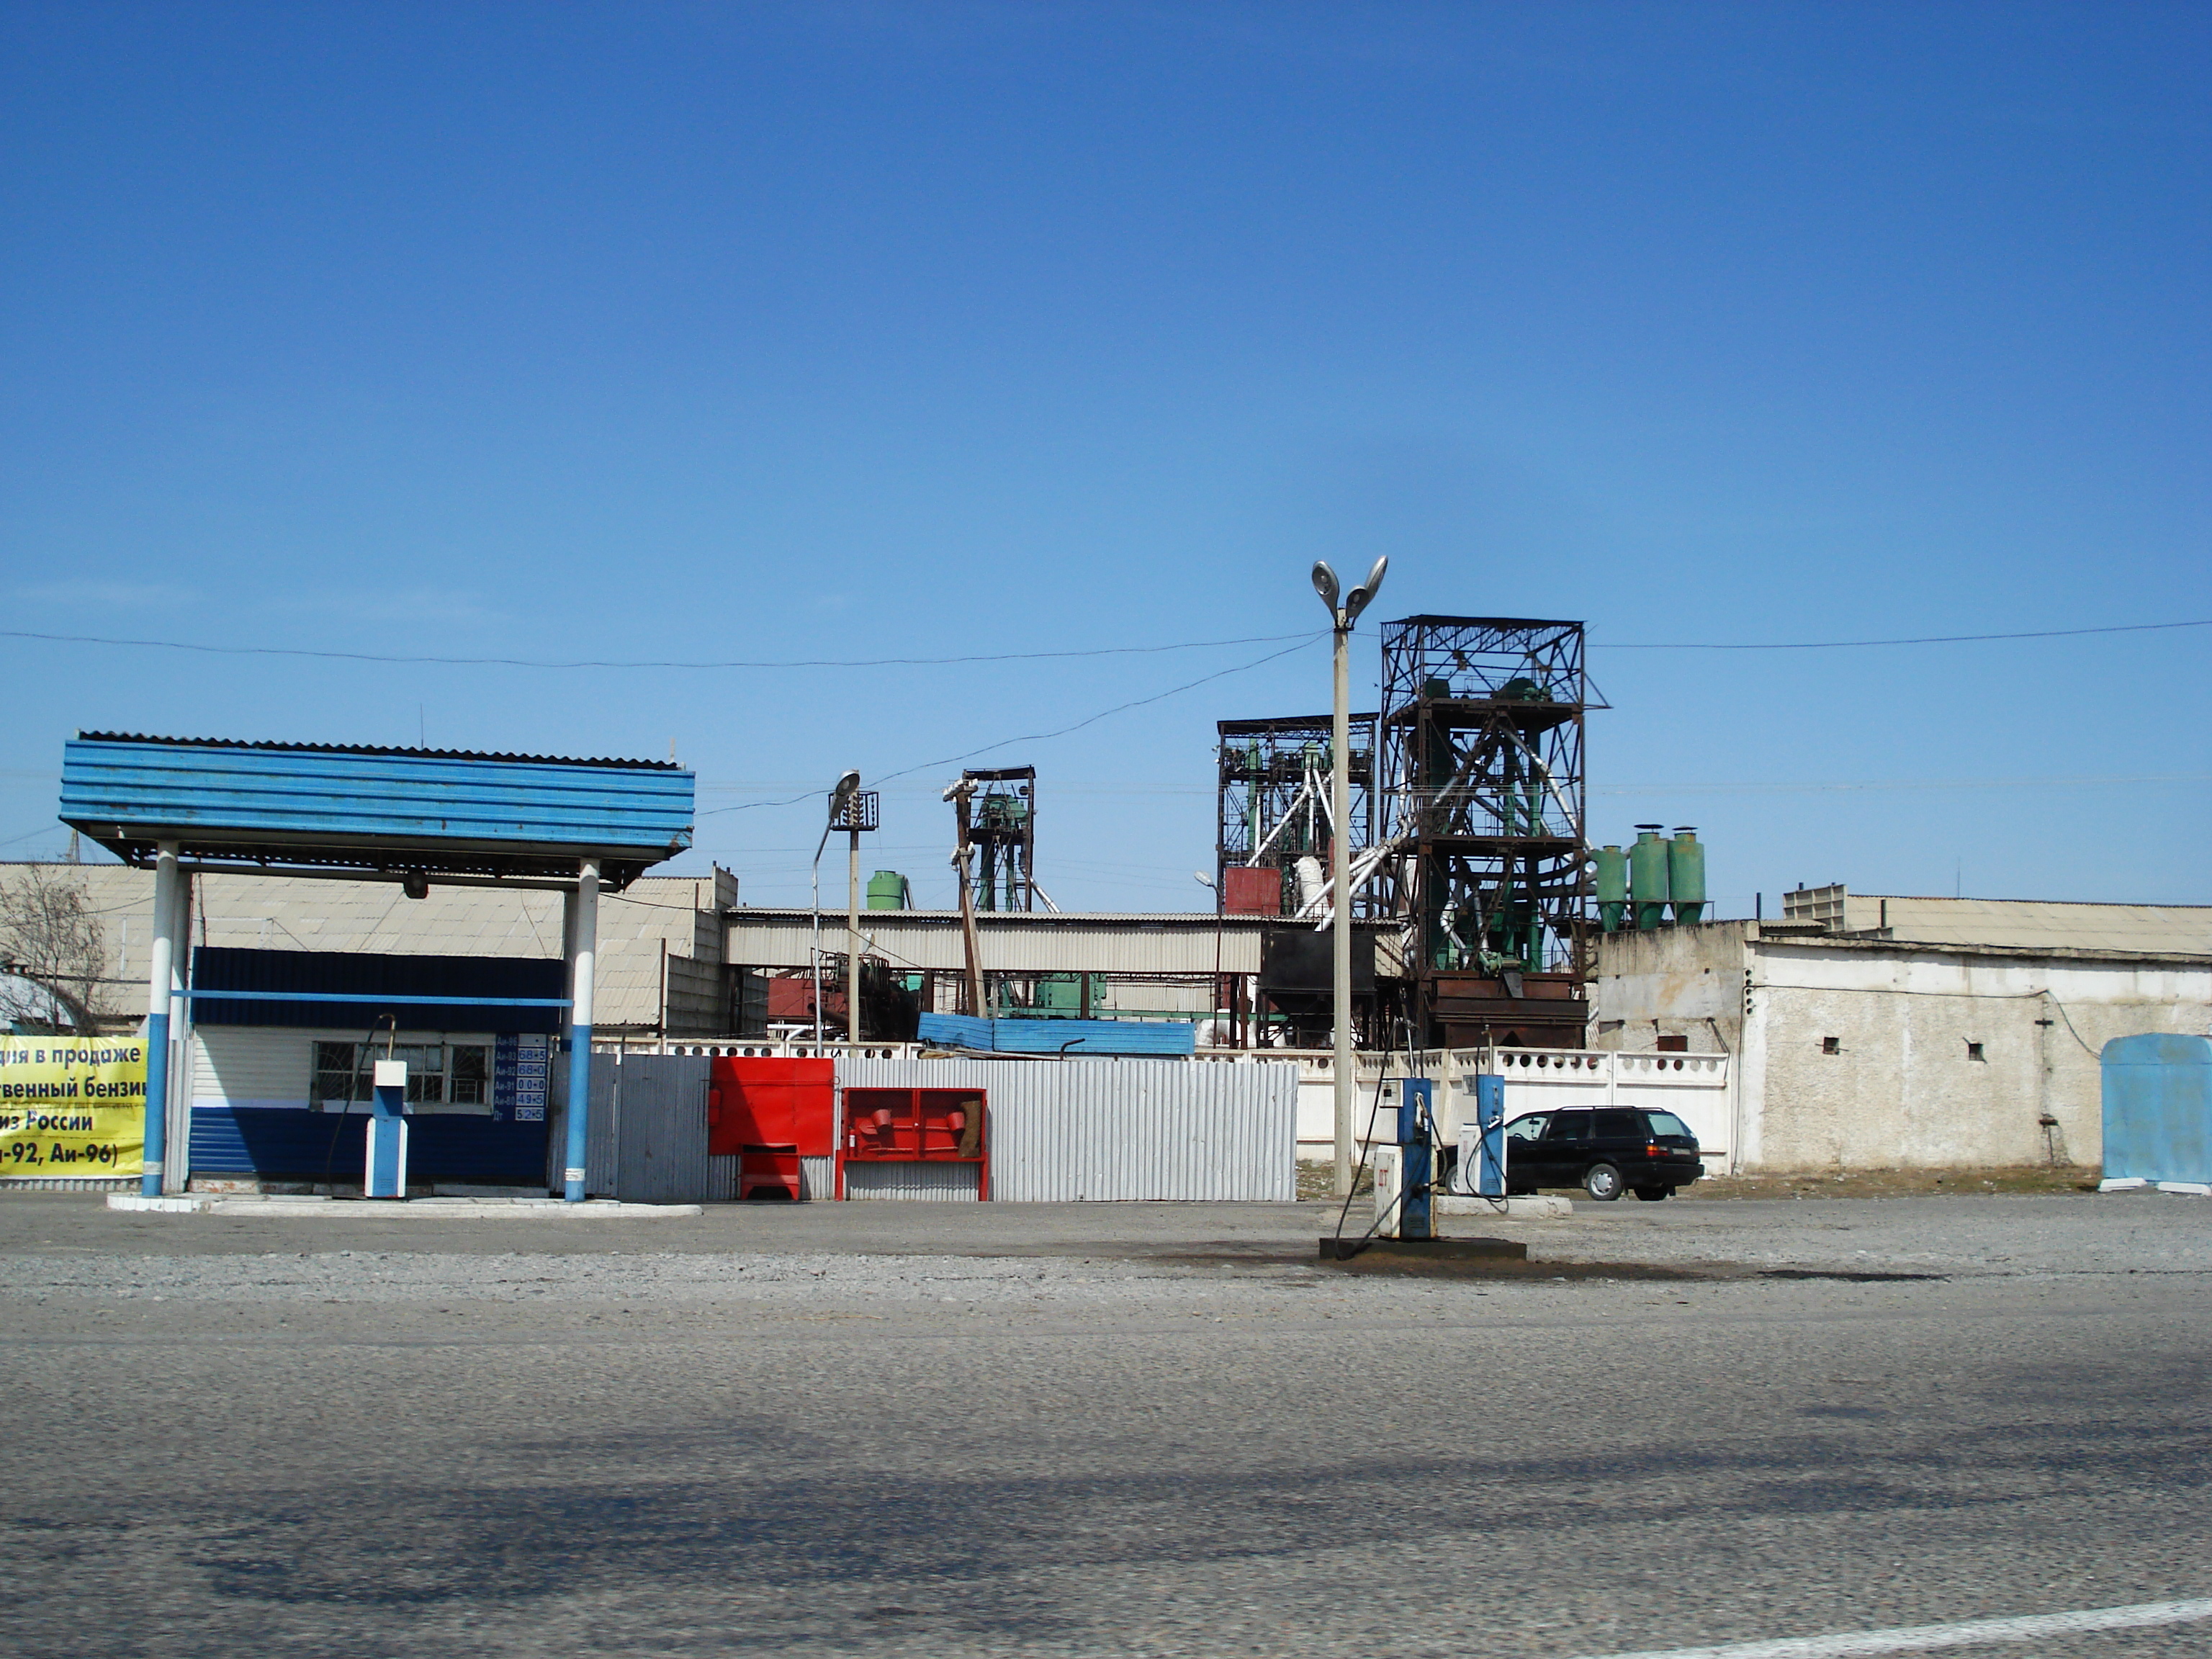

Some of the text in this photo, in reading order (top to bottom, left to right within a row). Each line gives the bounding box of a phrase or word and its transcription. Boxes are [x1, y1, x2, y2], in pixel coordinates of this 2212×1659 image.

[35, 1050, 46, 1064] в
[52, 1047, 141, 1069] продаже
[0, 1076, 78, 1097] венный
[0, 1110, 94, 1131] из России
[0, 1142, 118, 1168] -92, Аи-96)
